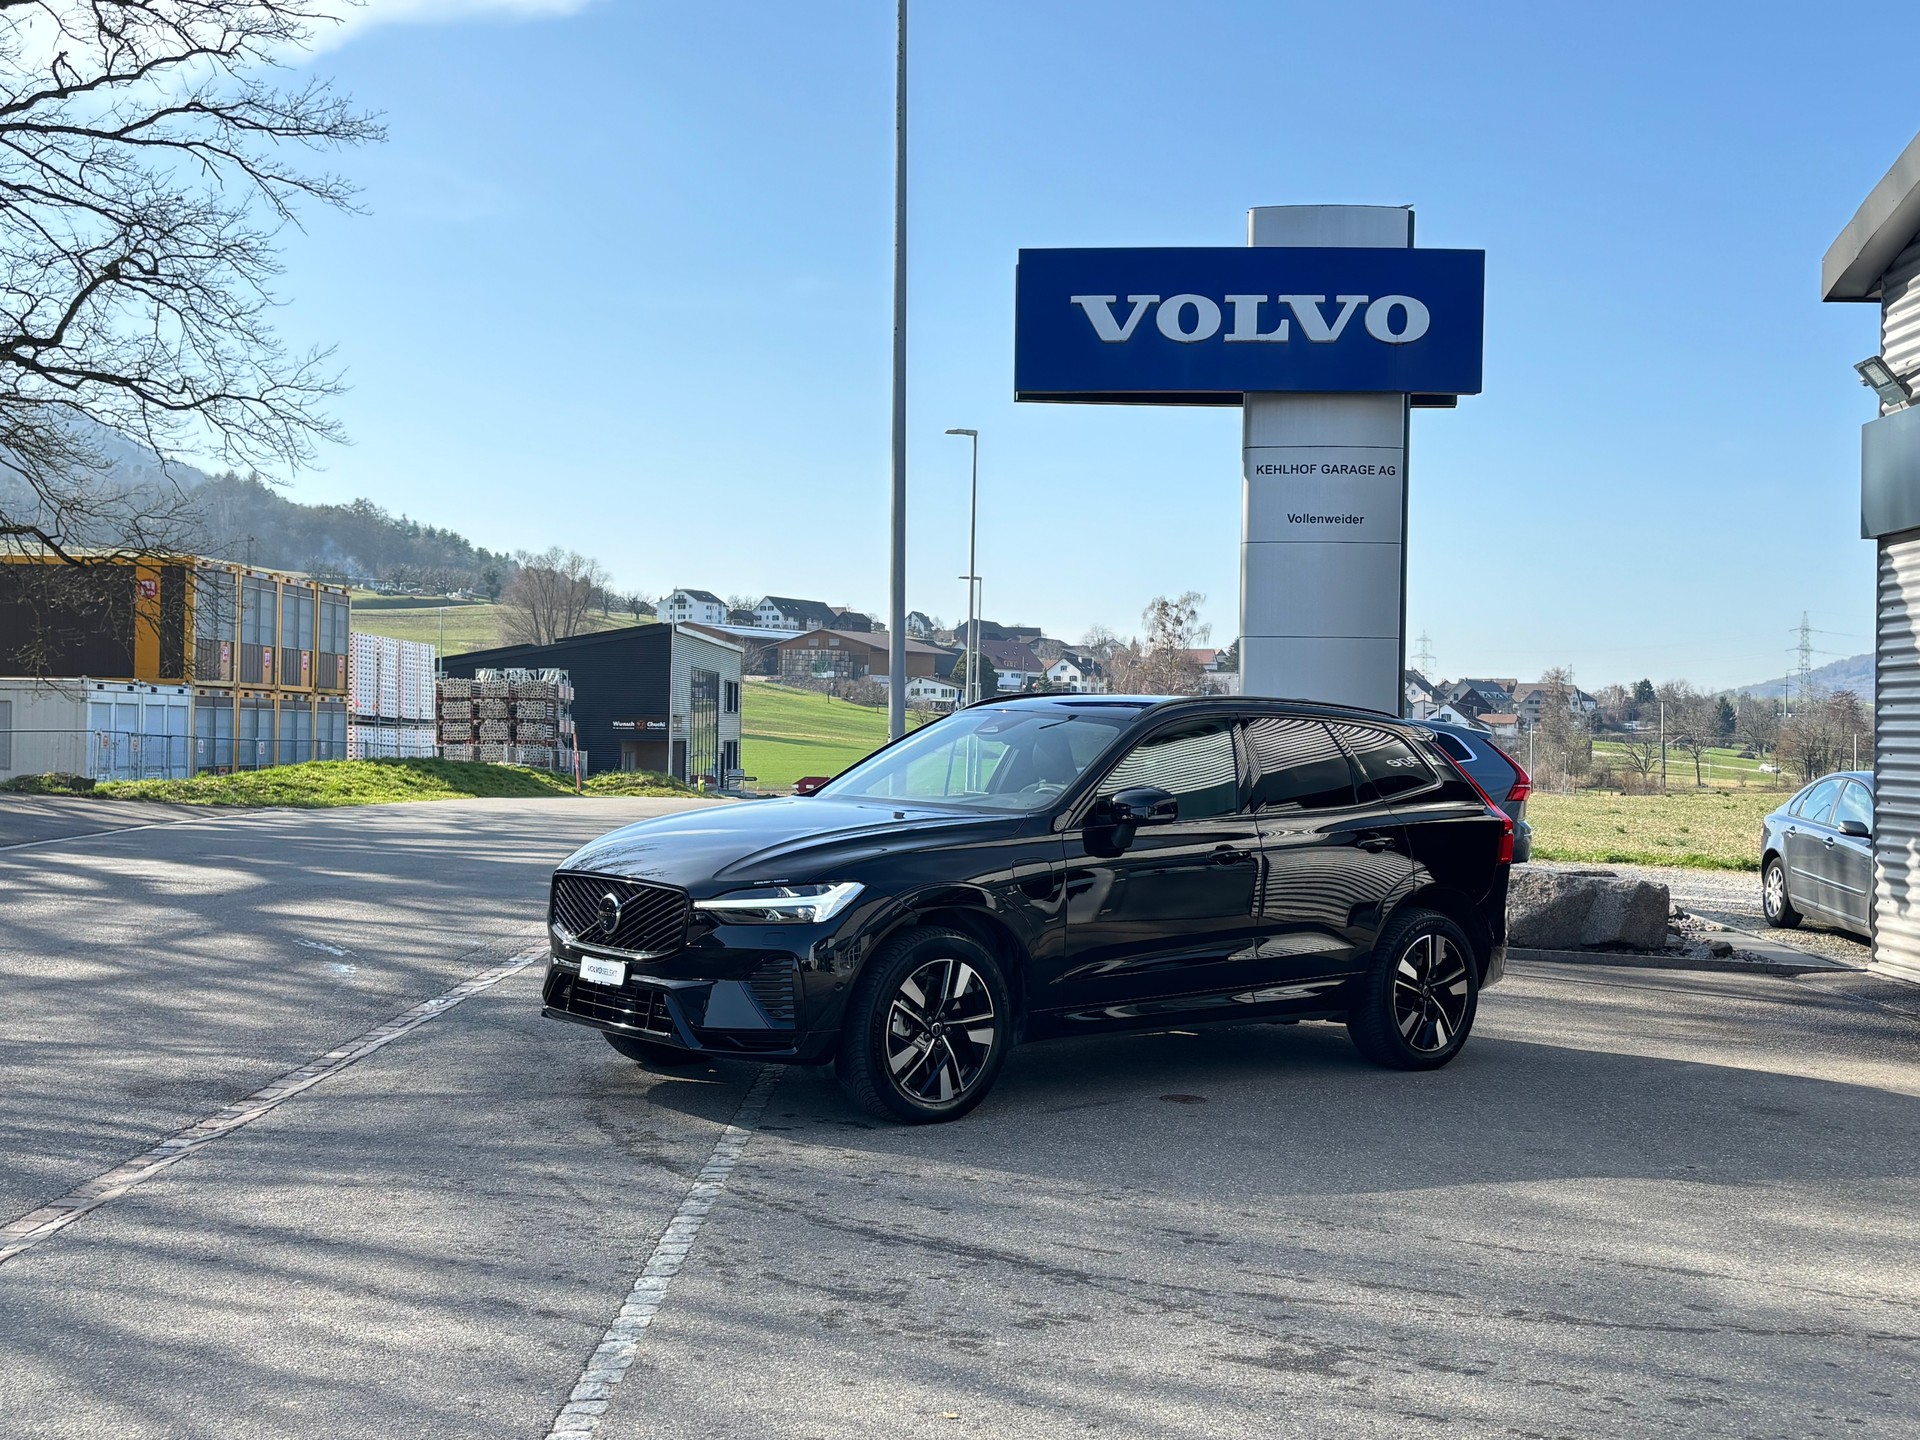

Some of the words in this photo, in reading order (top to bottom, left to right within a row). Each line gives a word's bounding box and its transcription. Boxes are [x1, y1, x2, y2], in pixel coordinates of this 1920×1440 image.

[1071, 294, 1430, 344] VOLVO
[1256, 464, 1317, 475] KEHLHOF
[1321, 464, 1375, 475] GARAGE
[1378, 465, 1396, 476] AG
[1287, 513, 1365, 525] Vollenweider
